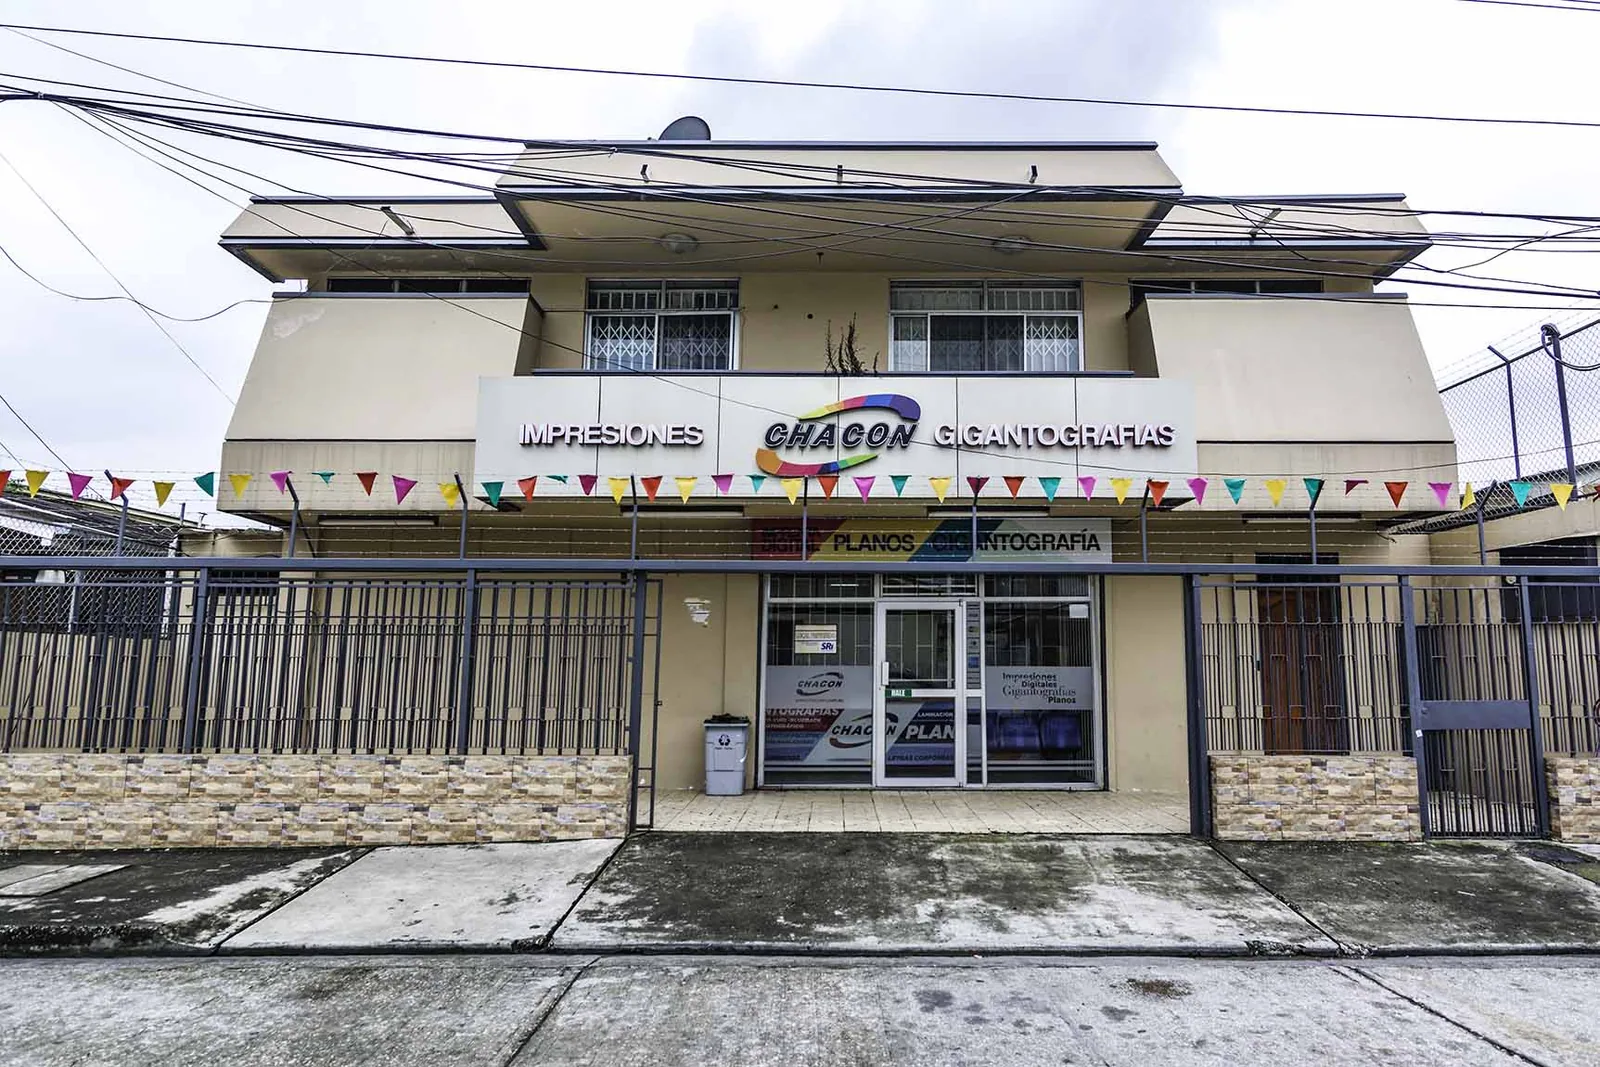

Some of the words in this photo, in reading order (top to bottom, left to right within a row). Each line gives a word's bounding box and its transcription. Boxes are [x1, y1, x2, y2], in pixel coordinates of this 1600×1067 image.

[518, 423, 705, 447] IMPRESIONES
[764, 422, 919, 449] CHACON
[933, 423, 1177, 447] GIGANTOGRAFIAS
[833, 533, 916, 552] PLANOS
[932, 528, 1102, 552] GIGANTOGRAFÍA
[797, 680, 843, 688] CHACON
[1002, 672, 1057, 682] Impresiones
[1047, 696, 1077, 704] Planos
[831, 725, 897, 736] CHACN
